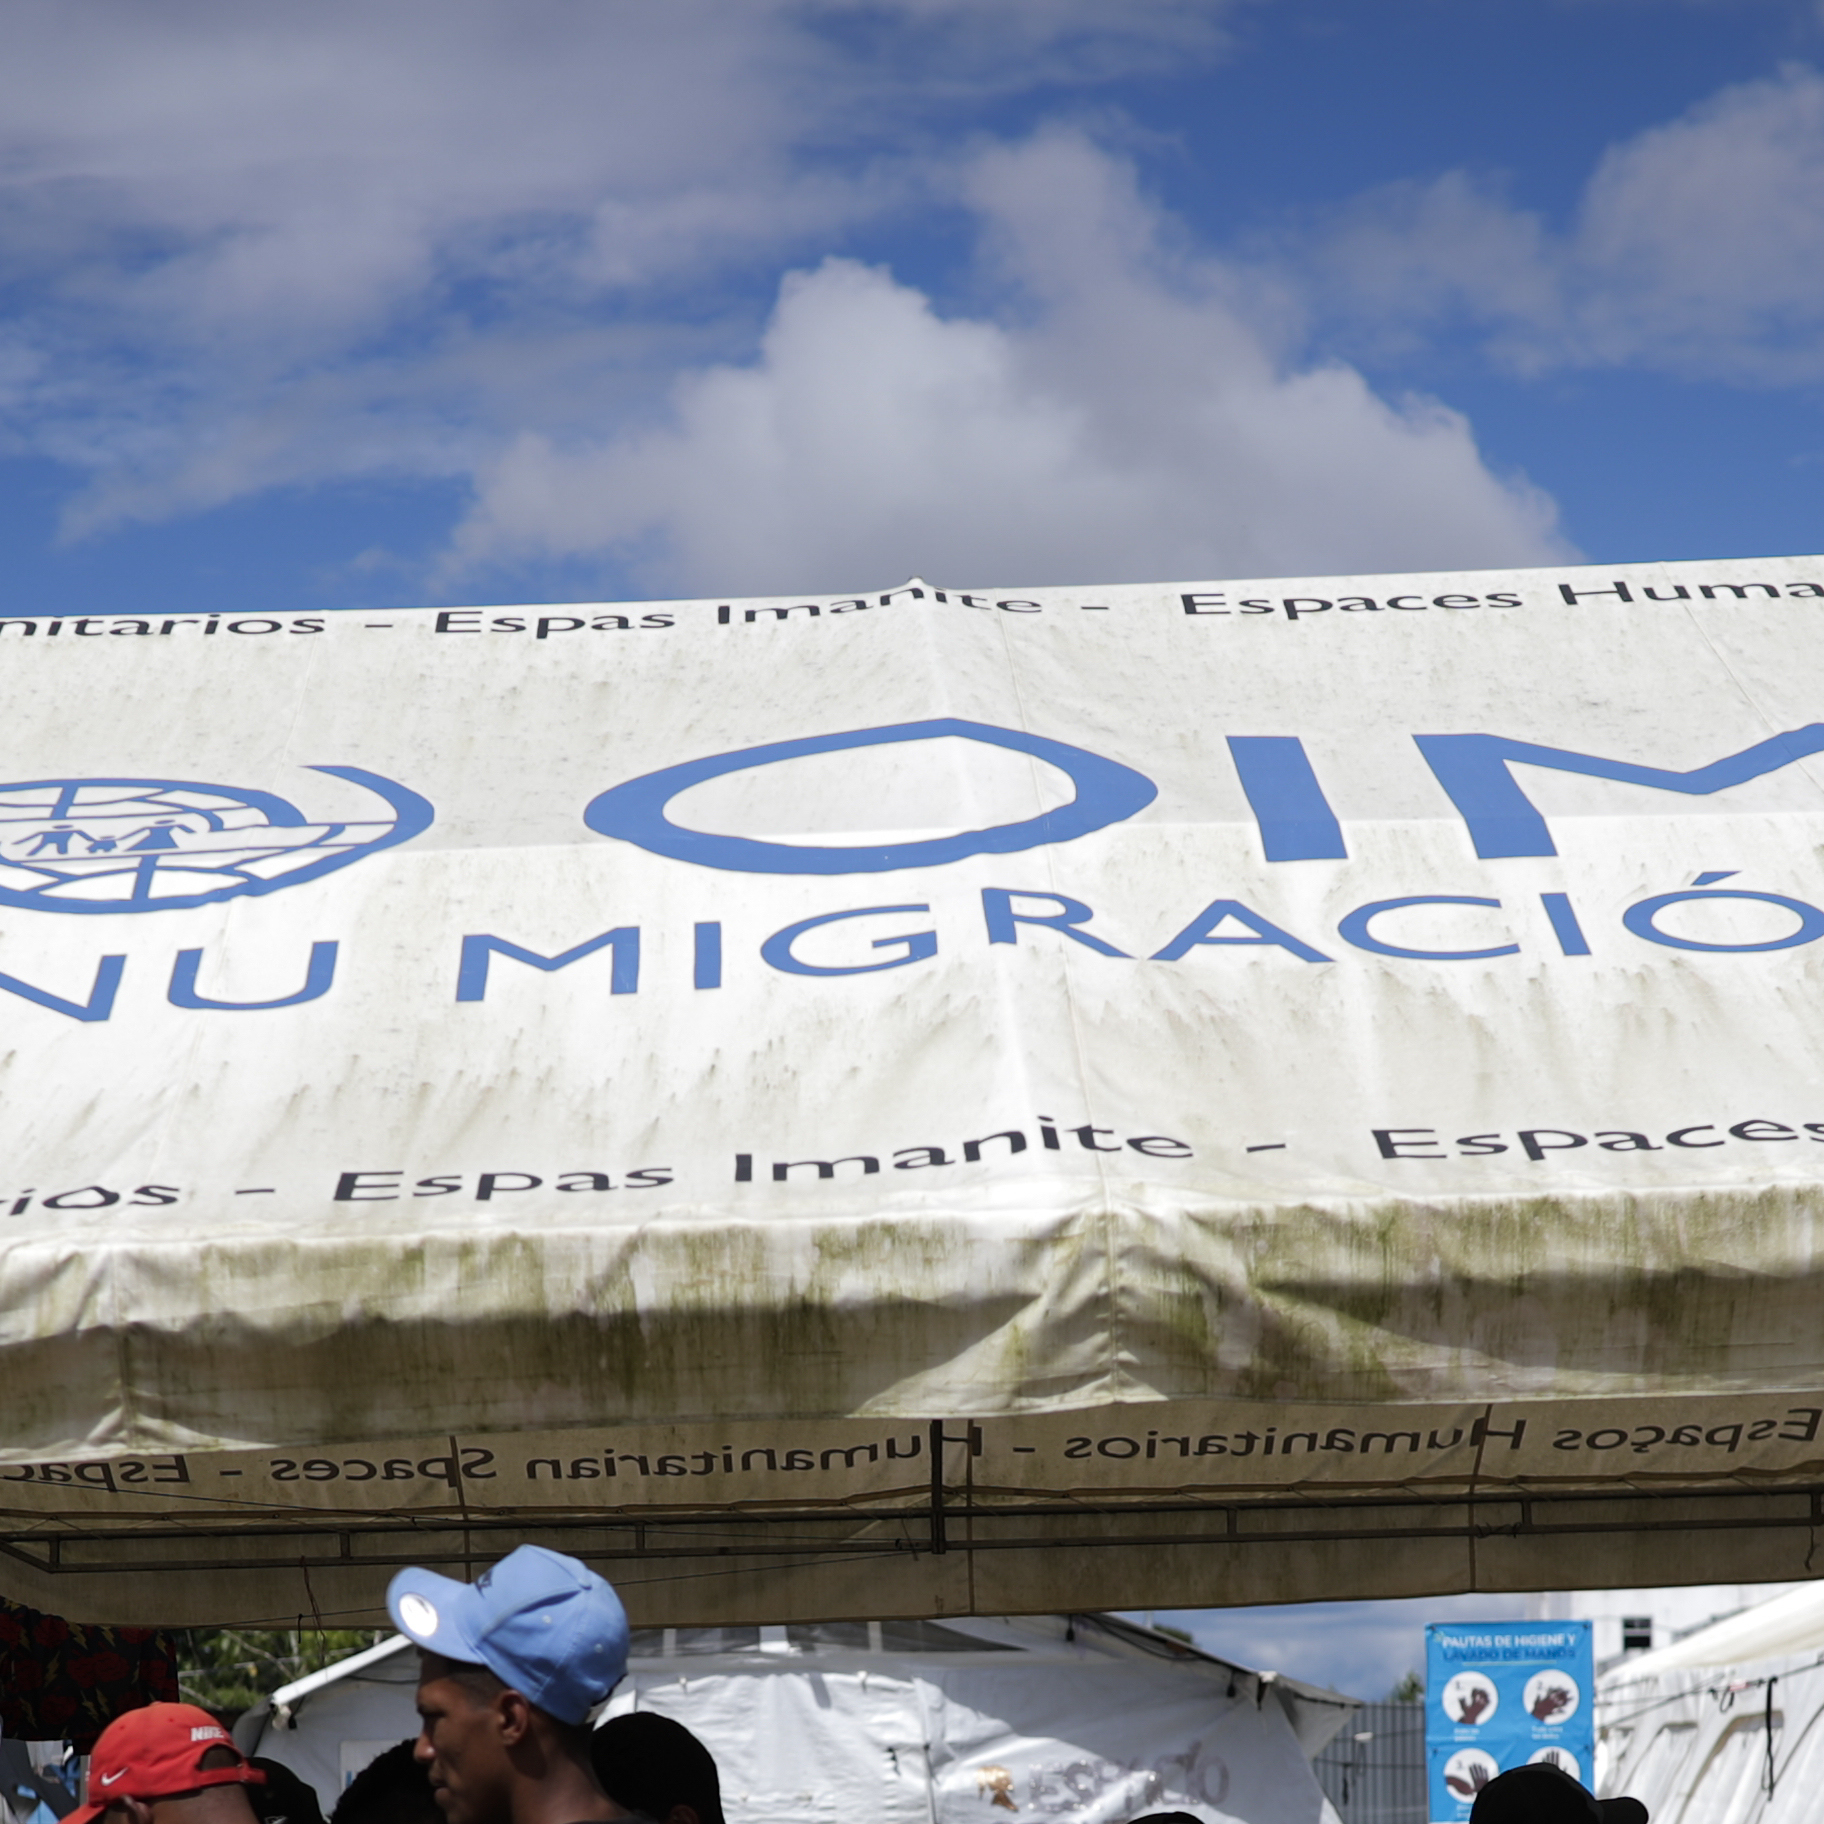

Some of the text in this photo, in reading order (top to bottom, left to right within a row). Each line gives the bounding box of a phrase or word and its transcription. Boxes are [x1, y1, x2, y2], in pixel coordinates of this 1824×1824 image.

[435, 610, 676, 640] Espas
[717, 586, 1043, 624] Imanite
[1182, 591, 1524, 620] Espaces
[332, 1166, 676, 1201] Espas
[734, 1114, 1194, 1183] Imanite
[1495, 1635, 1512, 1647] DE
[1514, 1633, 1566, 1647] HIGIENE
[1568, 1632, 1577, 1646] Y
